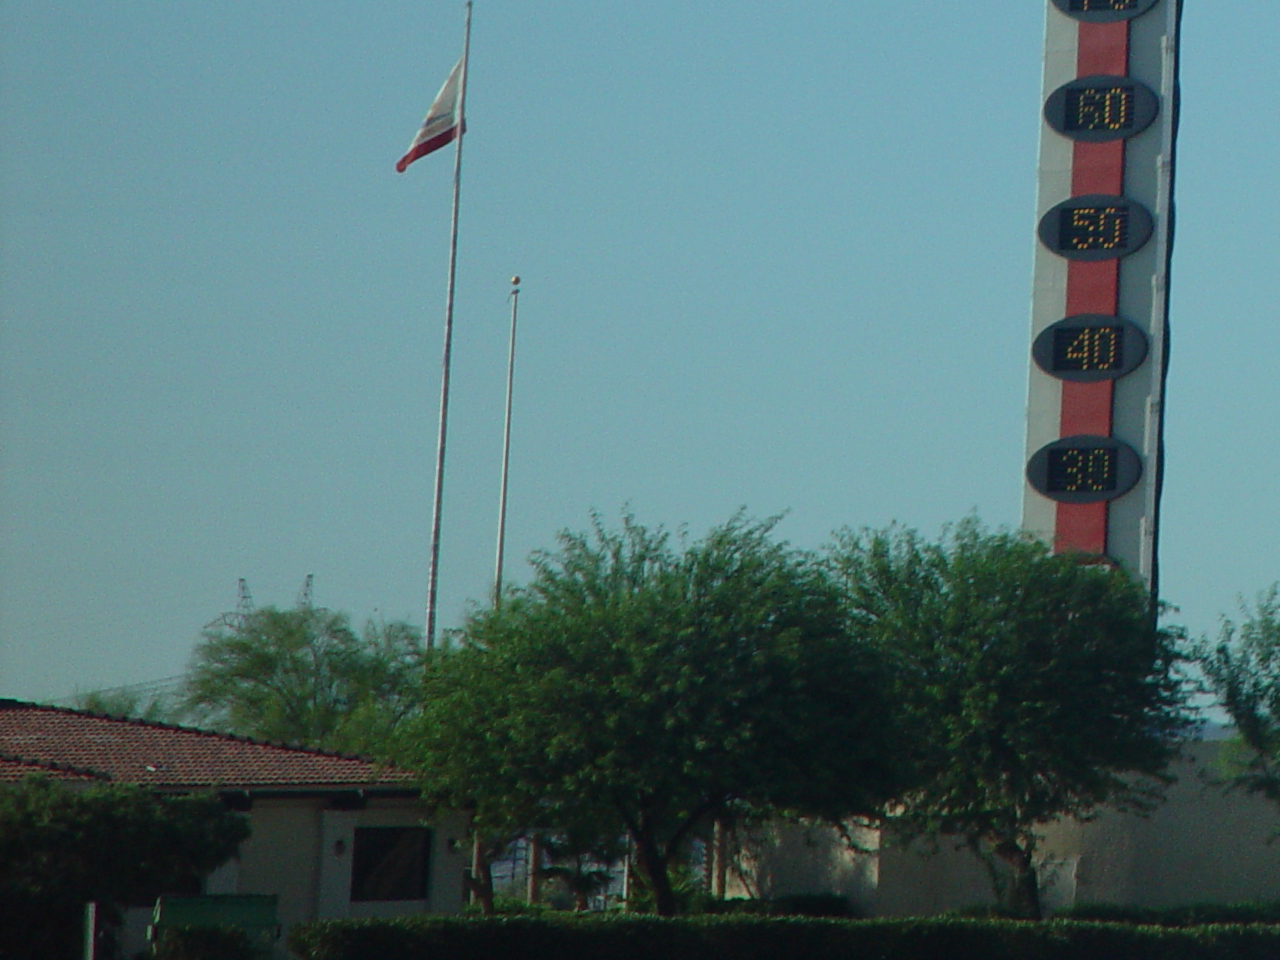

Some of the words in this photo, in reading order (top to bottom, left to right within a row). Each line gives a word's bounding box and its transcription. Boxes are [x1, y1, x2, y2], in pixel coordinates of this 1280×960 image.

[1078, 87, 1126, 130] 60
[1072, 207, 1121, 250] 50
[1067, 327, 1116, 370] 40
[1062, 449, 1109, 491] 30
